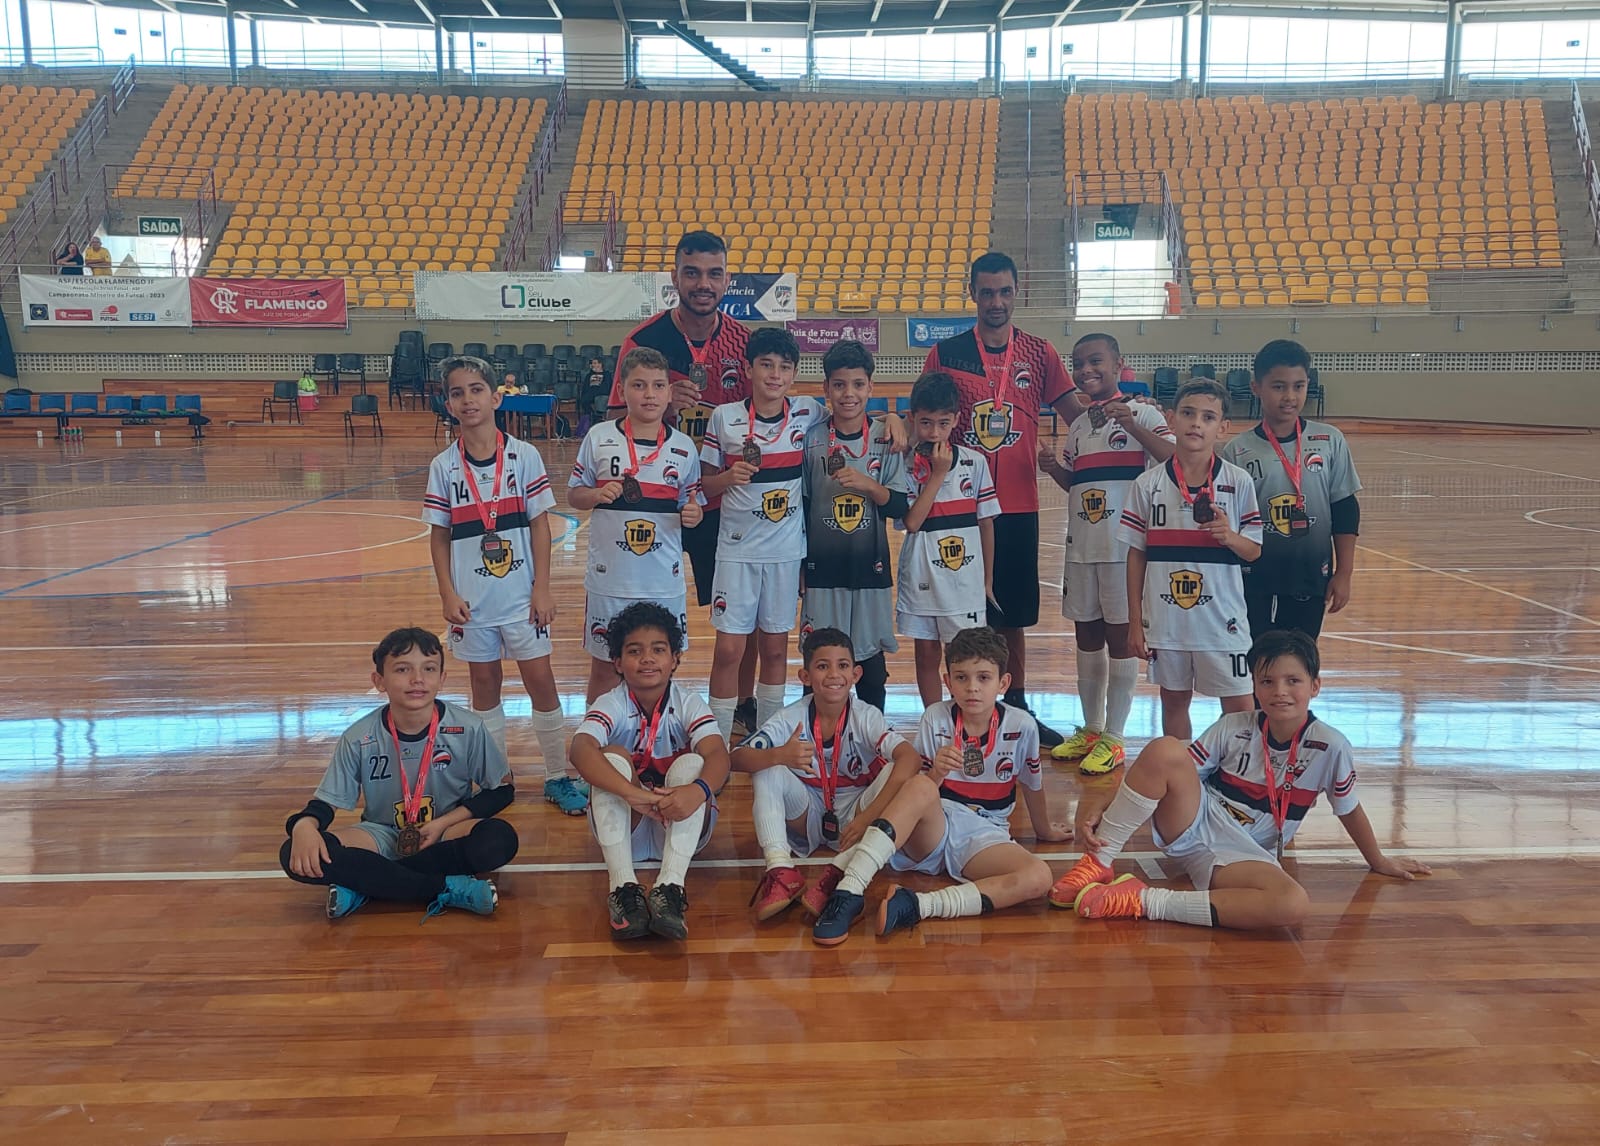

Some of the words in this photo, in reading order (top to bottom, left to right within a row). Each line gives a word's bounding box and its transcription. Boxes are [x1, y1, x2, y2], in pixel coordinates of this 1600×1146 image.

[142, 220, 179, 233] SAÍDA
[1097, 224, 1131, 238] SAÍDA
[48, 291, 89, 299] Campeonato
[244, 289, 296, 297] ESCOLA
[244, 299, 328, 310] FLAMENGO
[528, 298, 571, 308] clube
[132, 313, 153, 321] SESI
[808, 328, 819, 337] de
[820, 329, 839, 337] Fora
[610, 455, 620, 477] 6
[1246, 459, 1263, 481] 21
[452, 481, 470, 505] 14
[766, 497, 786, 510] TOP
[837, 503, 860, 518] TOP
[1085, 497, 1102, 511] TOP
[1151, 503, 1167, 527] 10
[629, 527, 652, 543] TOP
[943, 544, 962, 559] TOP
[1174, 580, 1198, 595] TOP
[1229, 653, 1248, 677] 10
[368, 755, 392, 782] 22
[401, 806, 429, 824] TP
